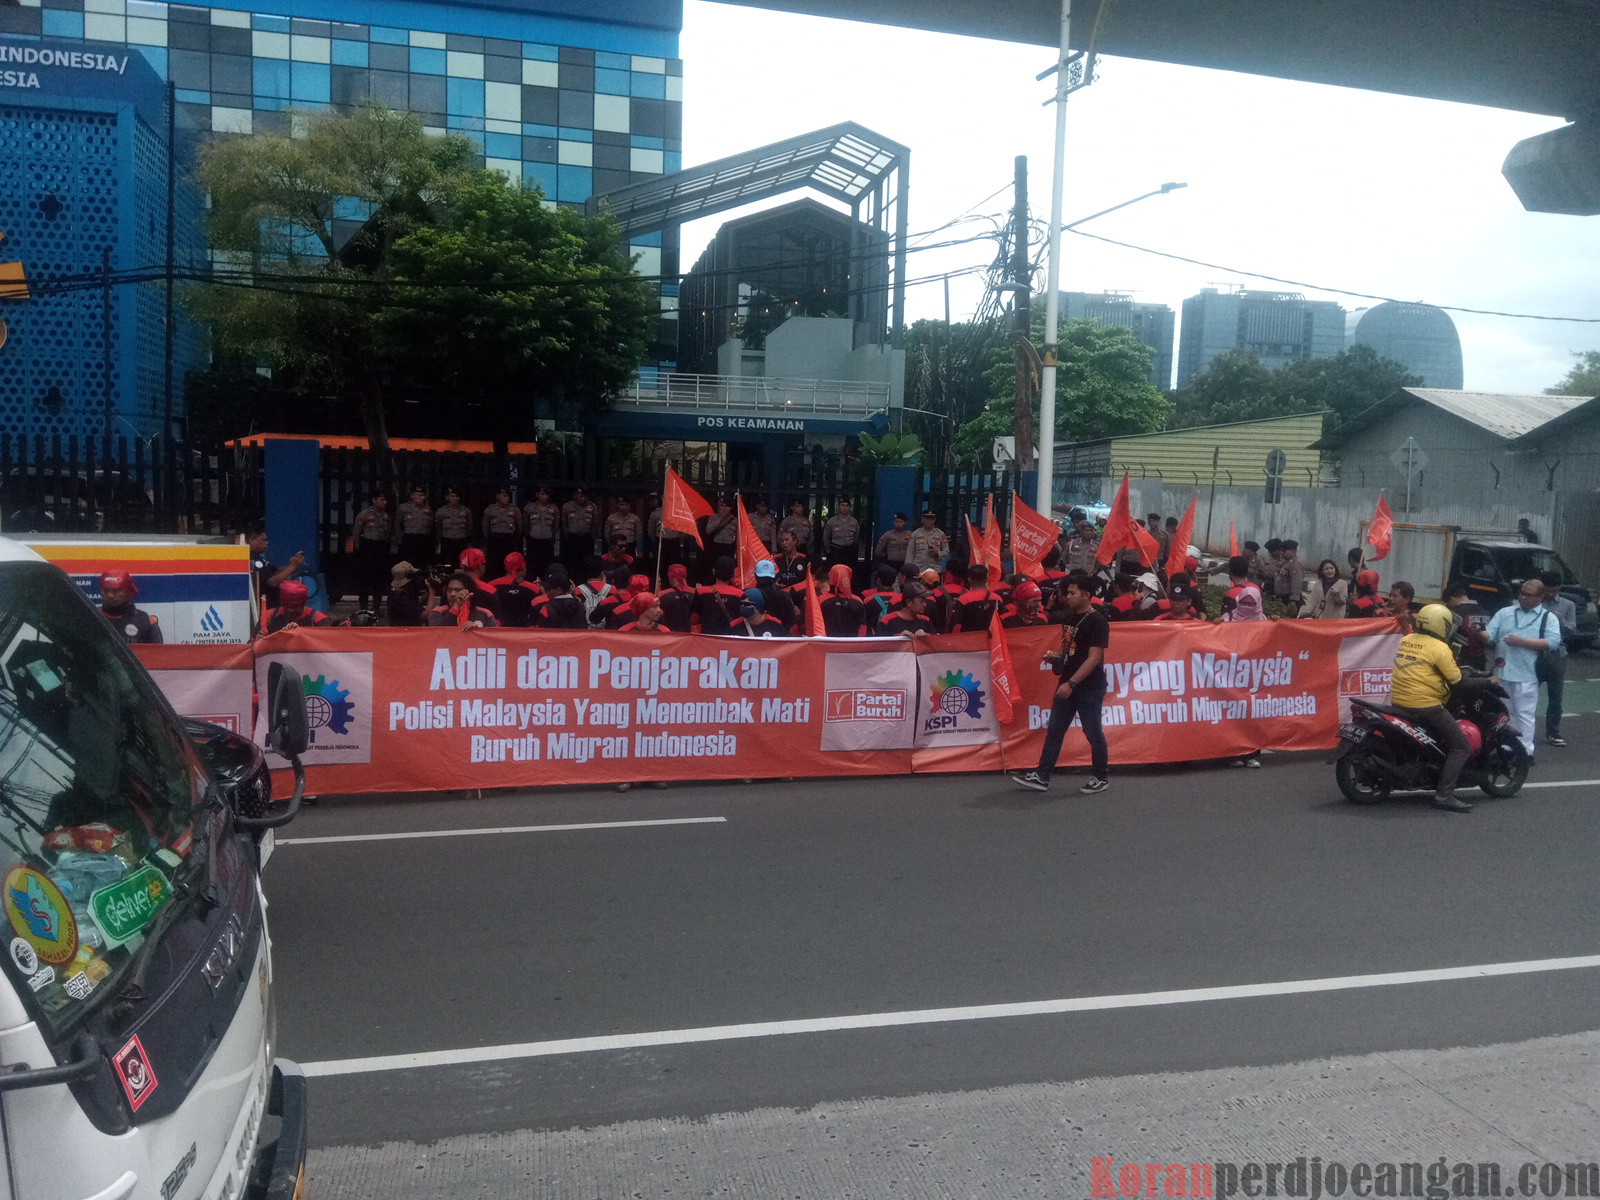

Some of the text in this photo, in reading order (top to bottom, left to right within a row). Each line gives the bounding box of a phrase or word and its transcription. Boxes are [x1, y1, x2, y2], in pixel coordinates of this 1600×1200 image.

[698, 416, 804, 431] POS KEAMANAN
[429, 648, 779, 696] Adili dan Penjarakan
[1191, 650, 1293, 693] Malaysia
[1363, 671, 1392, 682] Parta
[1363, 682, 1391, 693] Buru
[857, 693, 902, 705] Partai
[388, 697, 811, 731] Polisi Malaysia Yang Menembak Mati
[856, 705, 901, 717] Buruh
[1131, 699, 1188, 725] Buruh
[1192, 696, 1247, 724] Migran
[1250, 692, 1316, 719] Indonesia
[924, 715, 957, 731] KSPI
[470, 730, 737, 764] Buruh Migran Indonesia
